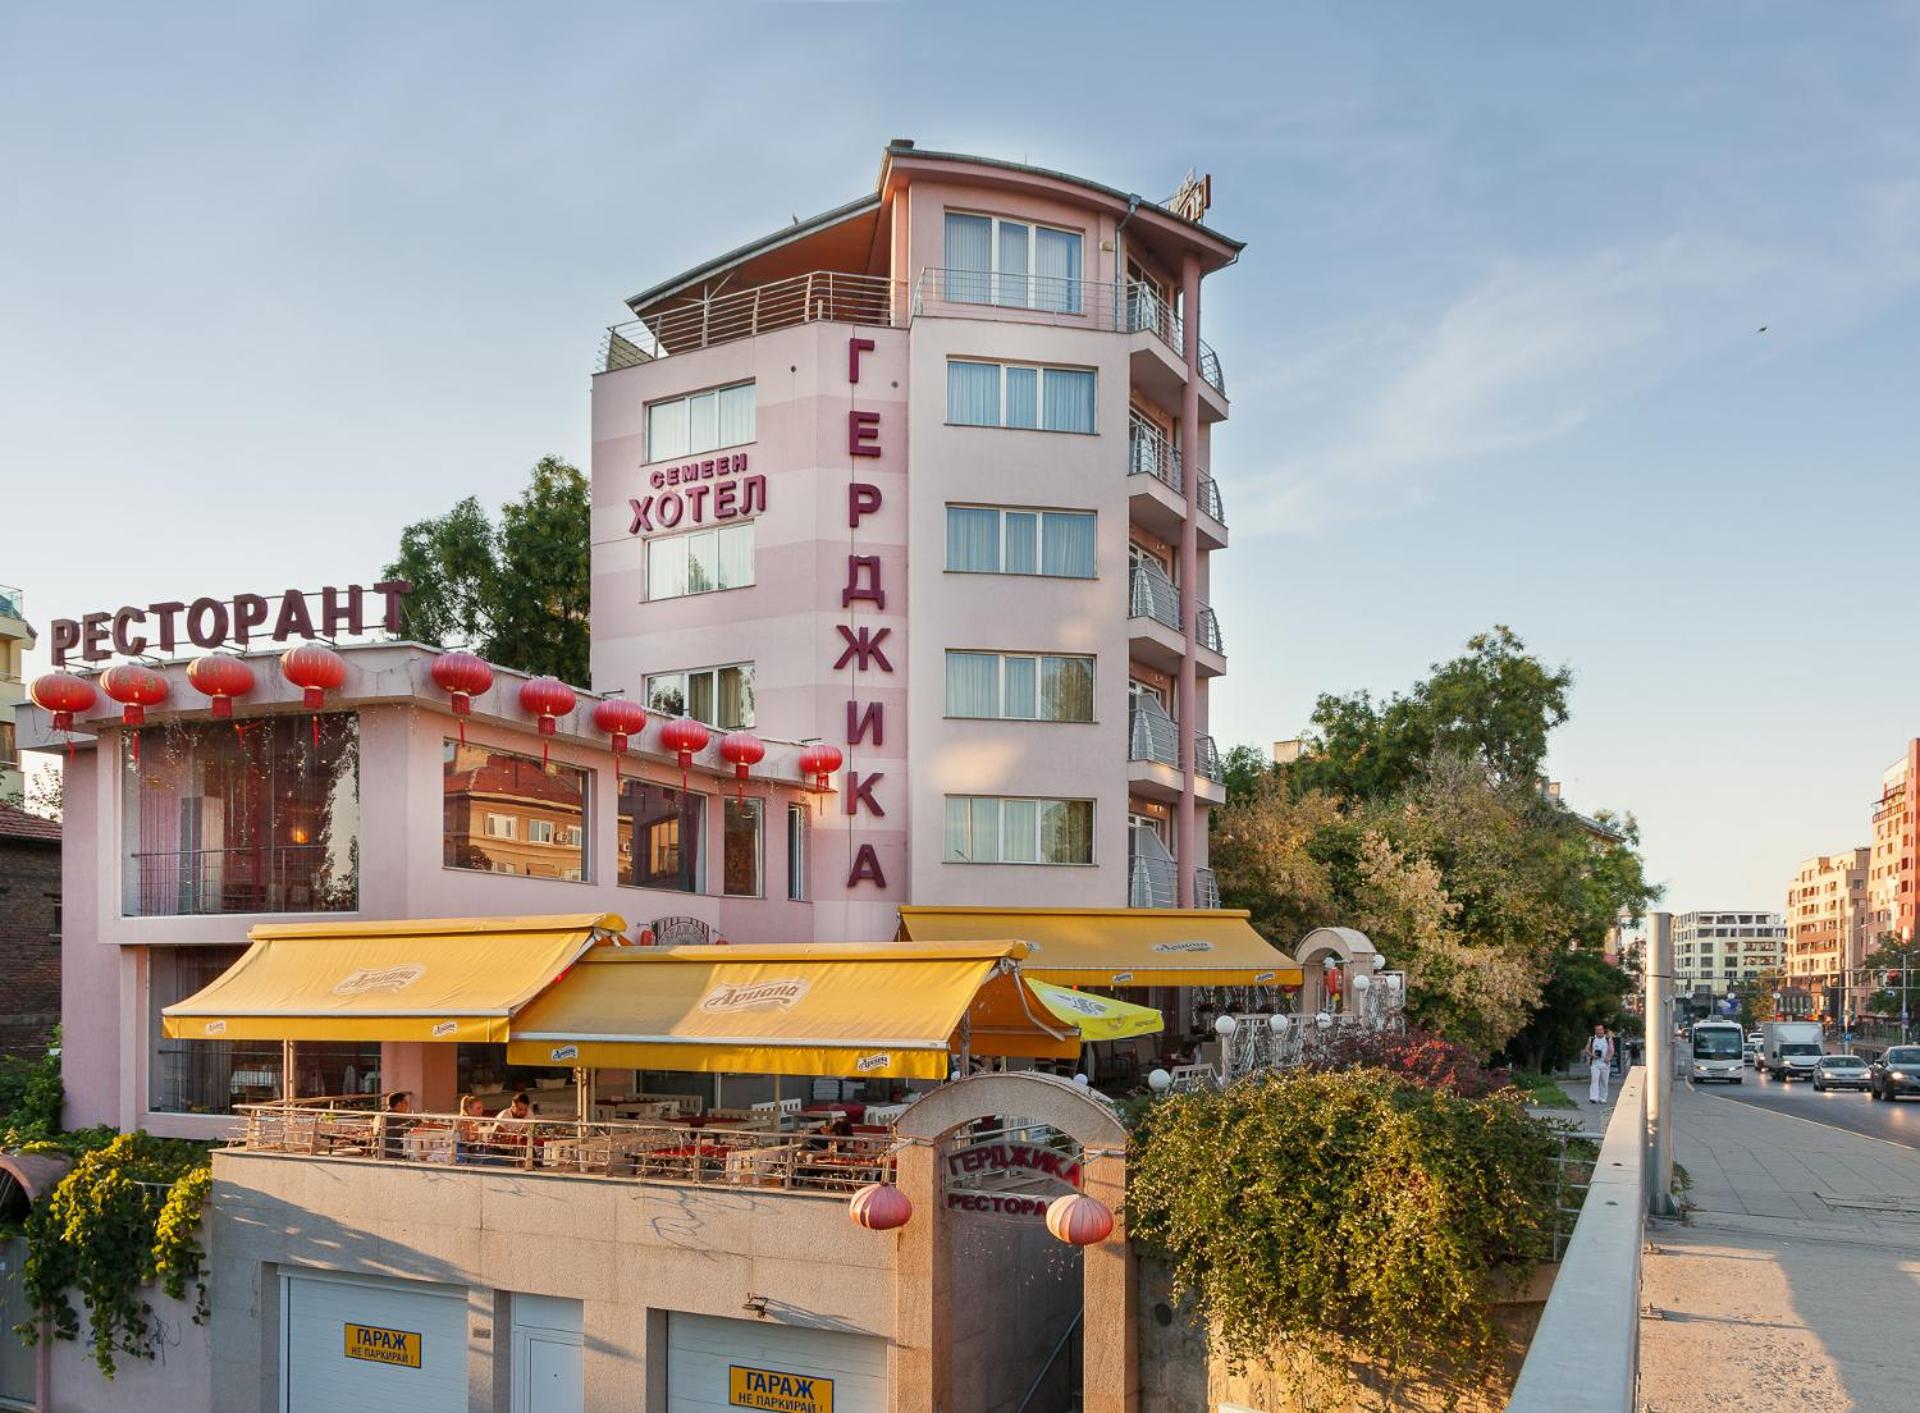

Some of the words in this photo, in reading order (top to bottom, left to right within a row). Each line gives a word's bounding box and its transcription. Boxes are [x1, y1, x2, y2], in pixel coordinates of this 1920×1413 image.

[650, 453, 748, 489] СЕМЕЕН
[629, 474, 767, 534] ХОТЕЛ
[51, 581, 413, 666] РЕСТОРАНТ
[833, 337, 893, 888] ГЕРДЖИКА
[704, 984, 799, 1009] Ариана
[948, 1144, 1082, 1187] ГЕРДЖИКА
[948, 1193, 1048, 1217] РЕСТОРА
[356, 1328, 407, 1350] ГАРАЖ
[351, 1346, 363, 1357] НЕ
[364, 1348, 408, 1363] ПАРКИРАЙ
[746, 1371, 815, 1400] ГАРАЖ
[738, 1392, 753, 1405] НЕ
[756, 1395, 816, 1413] ПАРКИРАЙ
